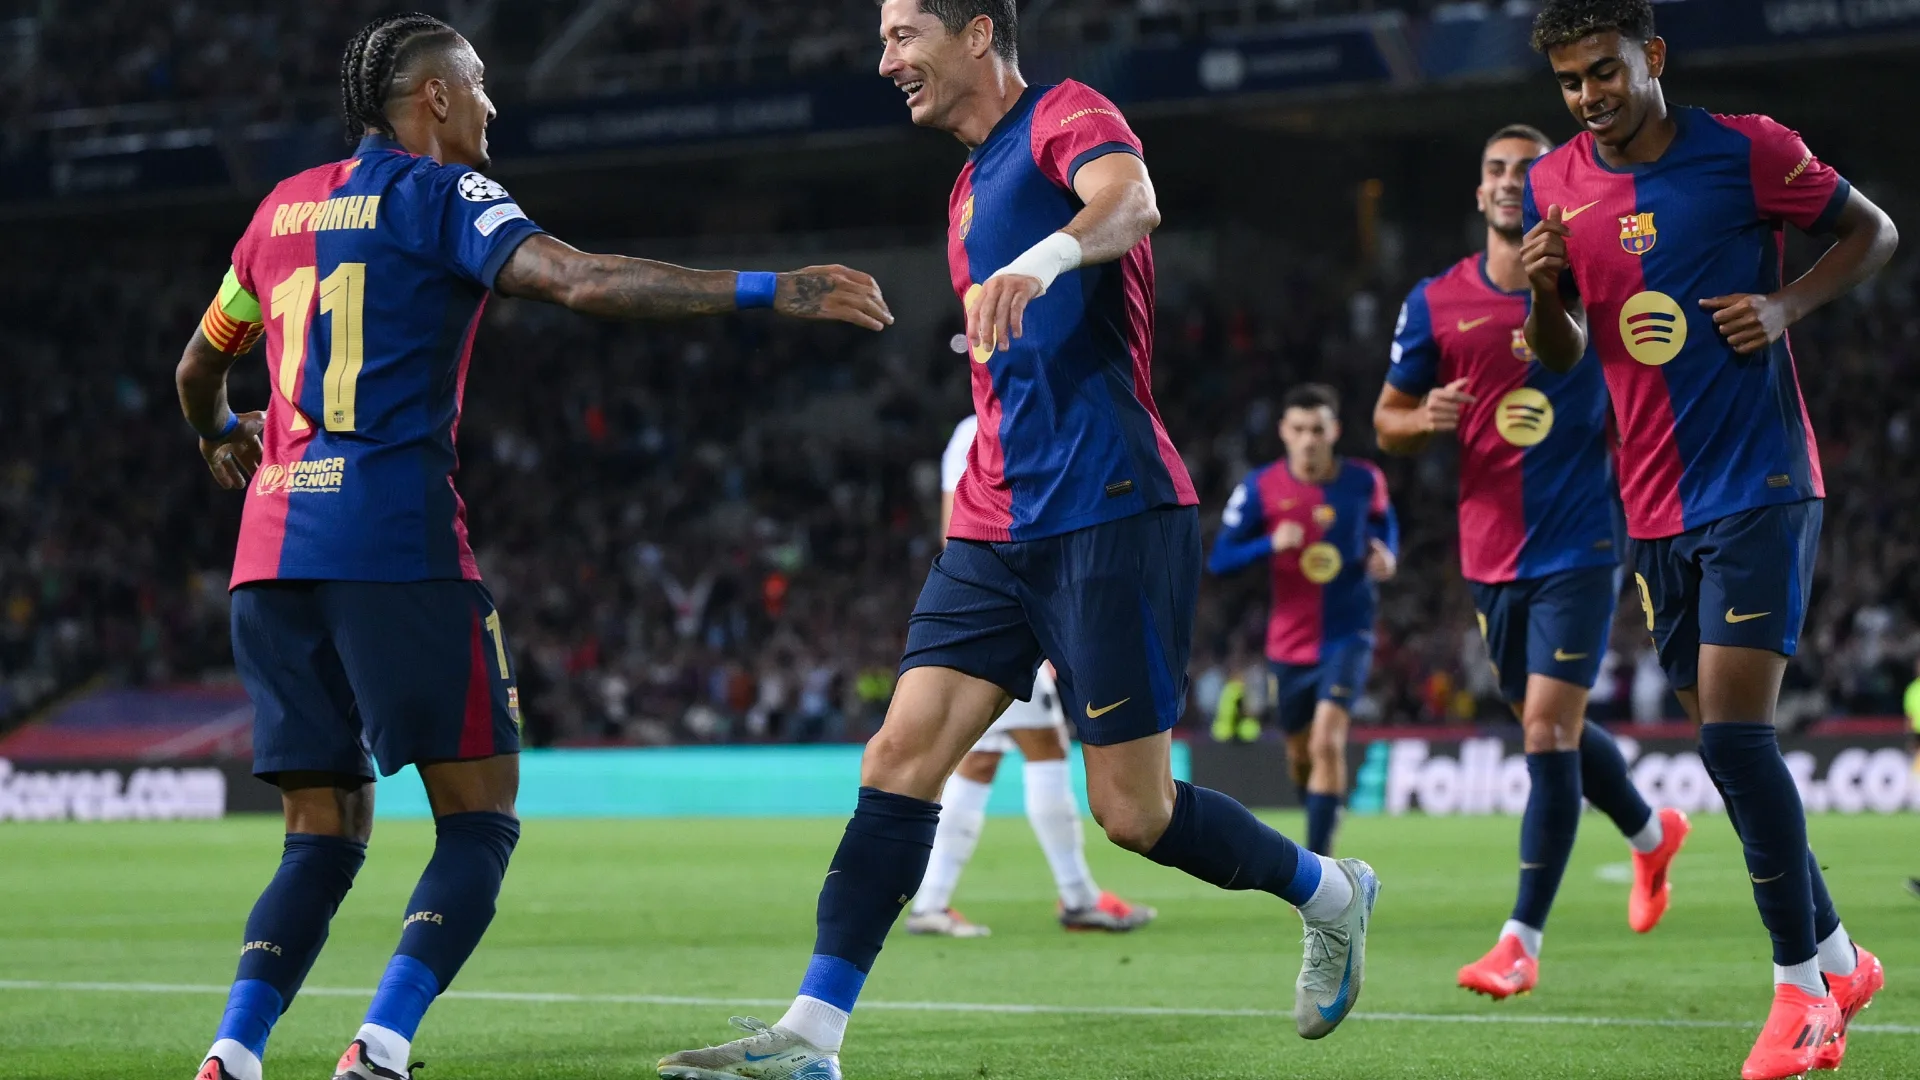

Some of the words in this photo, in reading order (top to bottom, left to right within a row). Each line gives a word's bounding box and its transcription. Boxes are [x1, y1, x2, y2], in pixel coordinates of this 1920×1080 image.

[270, 195, 381, 237] RAPHINHA
[270, 262, 366, 432] 11
[284, 471, 343, 489] ACNUR
[287, 457, 345, 474] UNHCR
[1386, 738, 1534, 815] Follo
